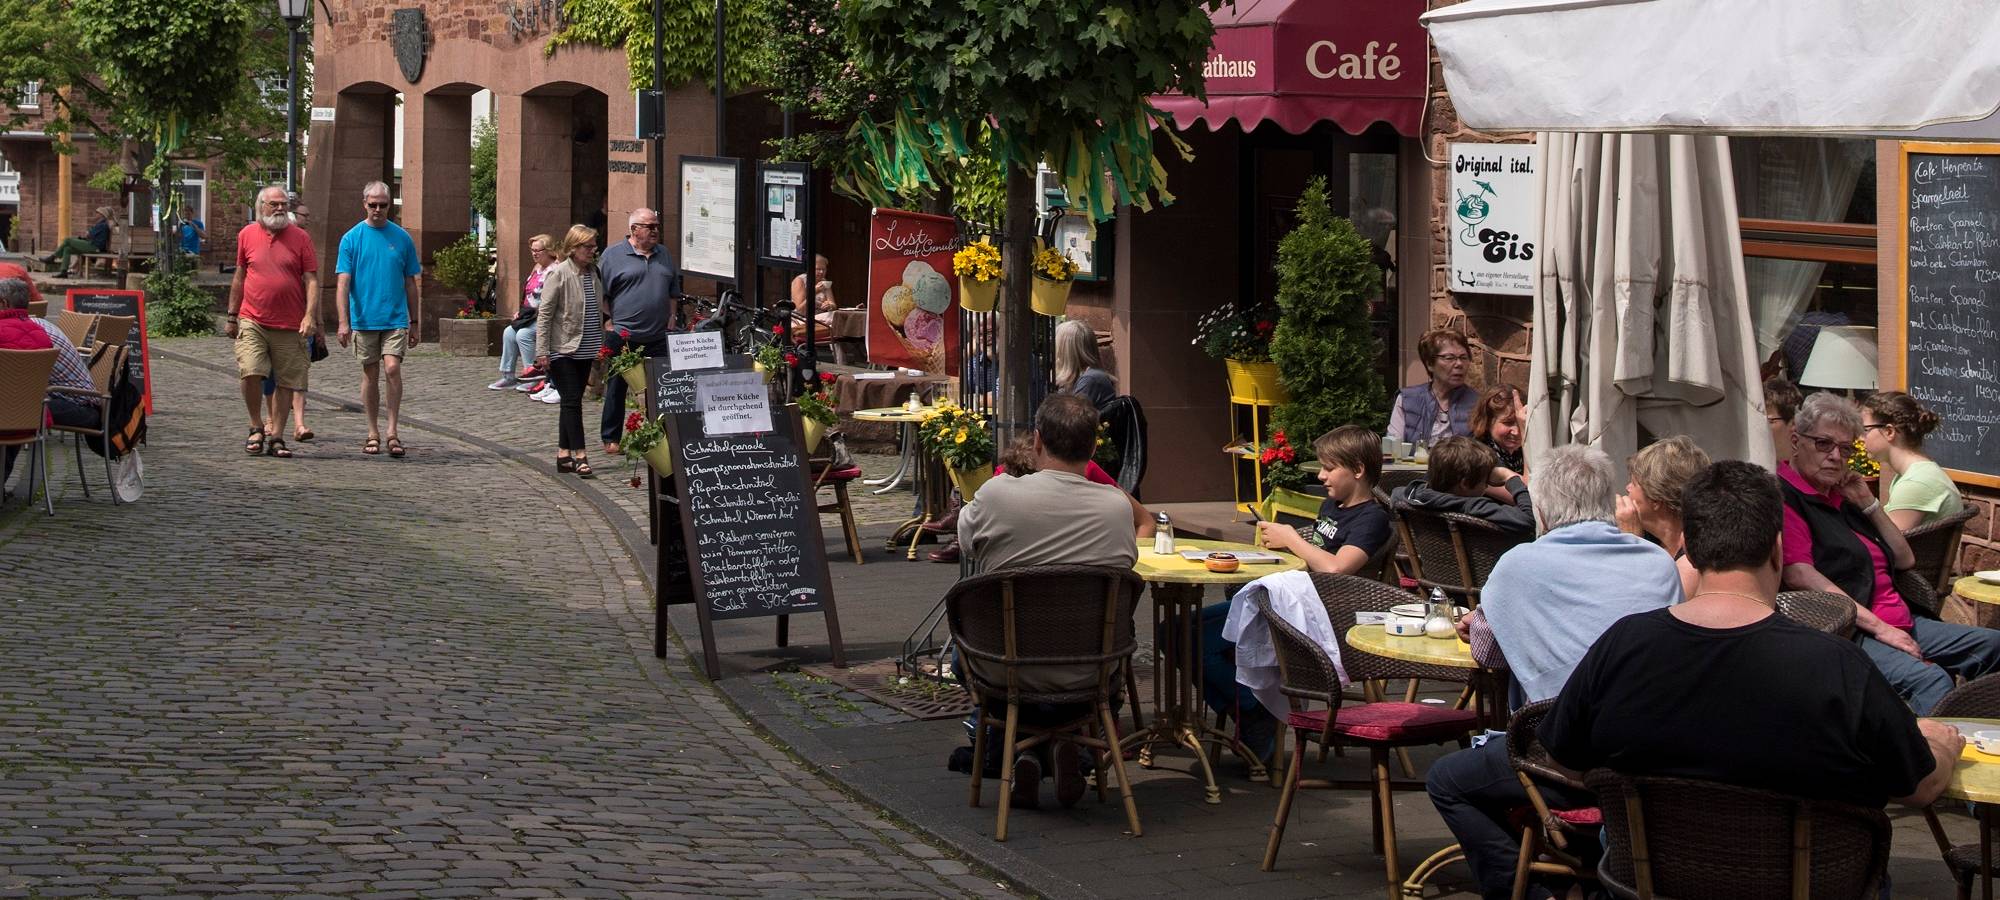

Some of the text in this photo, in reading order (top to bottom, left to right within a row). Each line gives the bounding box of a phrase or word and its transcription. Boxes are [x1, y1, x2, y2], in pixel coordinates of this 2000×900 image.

[1200, 54, 1257, 79] athaus
[1305, 40, 1401, 81] Café
[1455, 154, 1534, 177] Original ital.
[1915, 161, 1938, 182] Café
[875, 220, 927, 251] Lust
[903, 243, 921, 258] auf
[1478, 228, 1534, 263] Eis
[1910, 240, 1928, 253] mit
[1910, 255, 1928, 268] und
[1910, 312, 1928, 330] mit
[675, 338, 695, 346] Unsere
[680, 344, 717, 353] durchgehend
[711, 392, 760, 403] Unsere Küche
[717, 401, 763, 412] durchgehend
[721, 413, 752, 421] geöffnet.
[685, 438, 767, 458] Schnitzelparade
[692, 475, 778, 497] Paprikaschnitzel
[714, 493, 756, 508] Schnitzel
[700, 510, 744, 526] Schnitzel
[699, 534, 717, 546] als
[701, 549, 722, 559] wir
[720, 545, 762, 557] Pommes
[702, 554, 800, 574] Bratkartoffeln oder
[777, 565, 801, 577] und
[707, 588, 735, 599] einen
[712, 598, 748, 612] Salat
